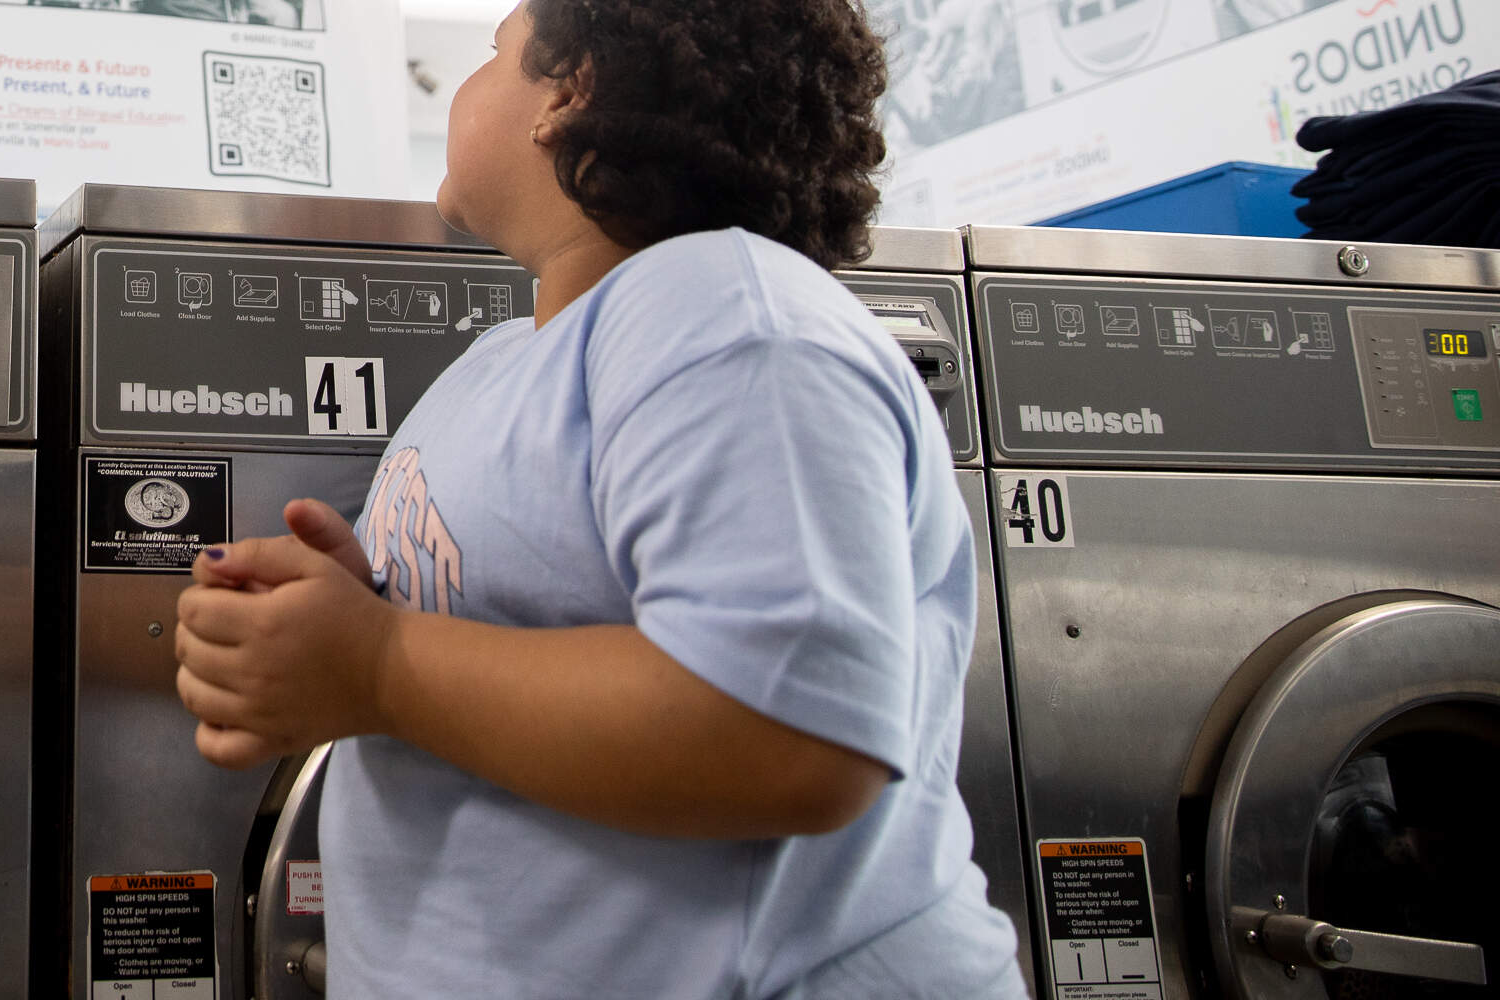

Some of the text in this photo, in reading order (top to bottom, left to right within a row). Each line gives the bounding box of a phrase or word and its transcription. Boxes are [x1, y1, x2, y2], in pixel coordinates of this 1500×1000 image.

[78, 60, 89, 72] &
[96, 61, 151, 77] Futuro
[4, 78, 72, 96] Present,
[78, 82, 90, 95] &
[97, 83, 150, 98] Future
[120, 382, 293, 416] Huebsch
[313, 362, 377, 430] 41
[1020, 405, 1164, 434] Huebsch
[1007, 478, 1066, 544] 40
[162, 542, 188, 551] Laundry
[1069, 844, 1127, 854] WARNING
[127, 877, 195, 888] WARNING
[134, 907, 147, 915] put
[1080, 900, 1099, 908] injury
[132, 937, 155, 947] injury
